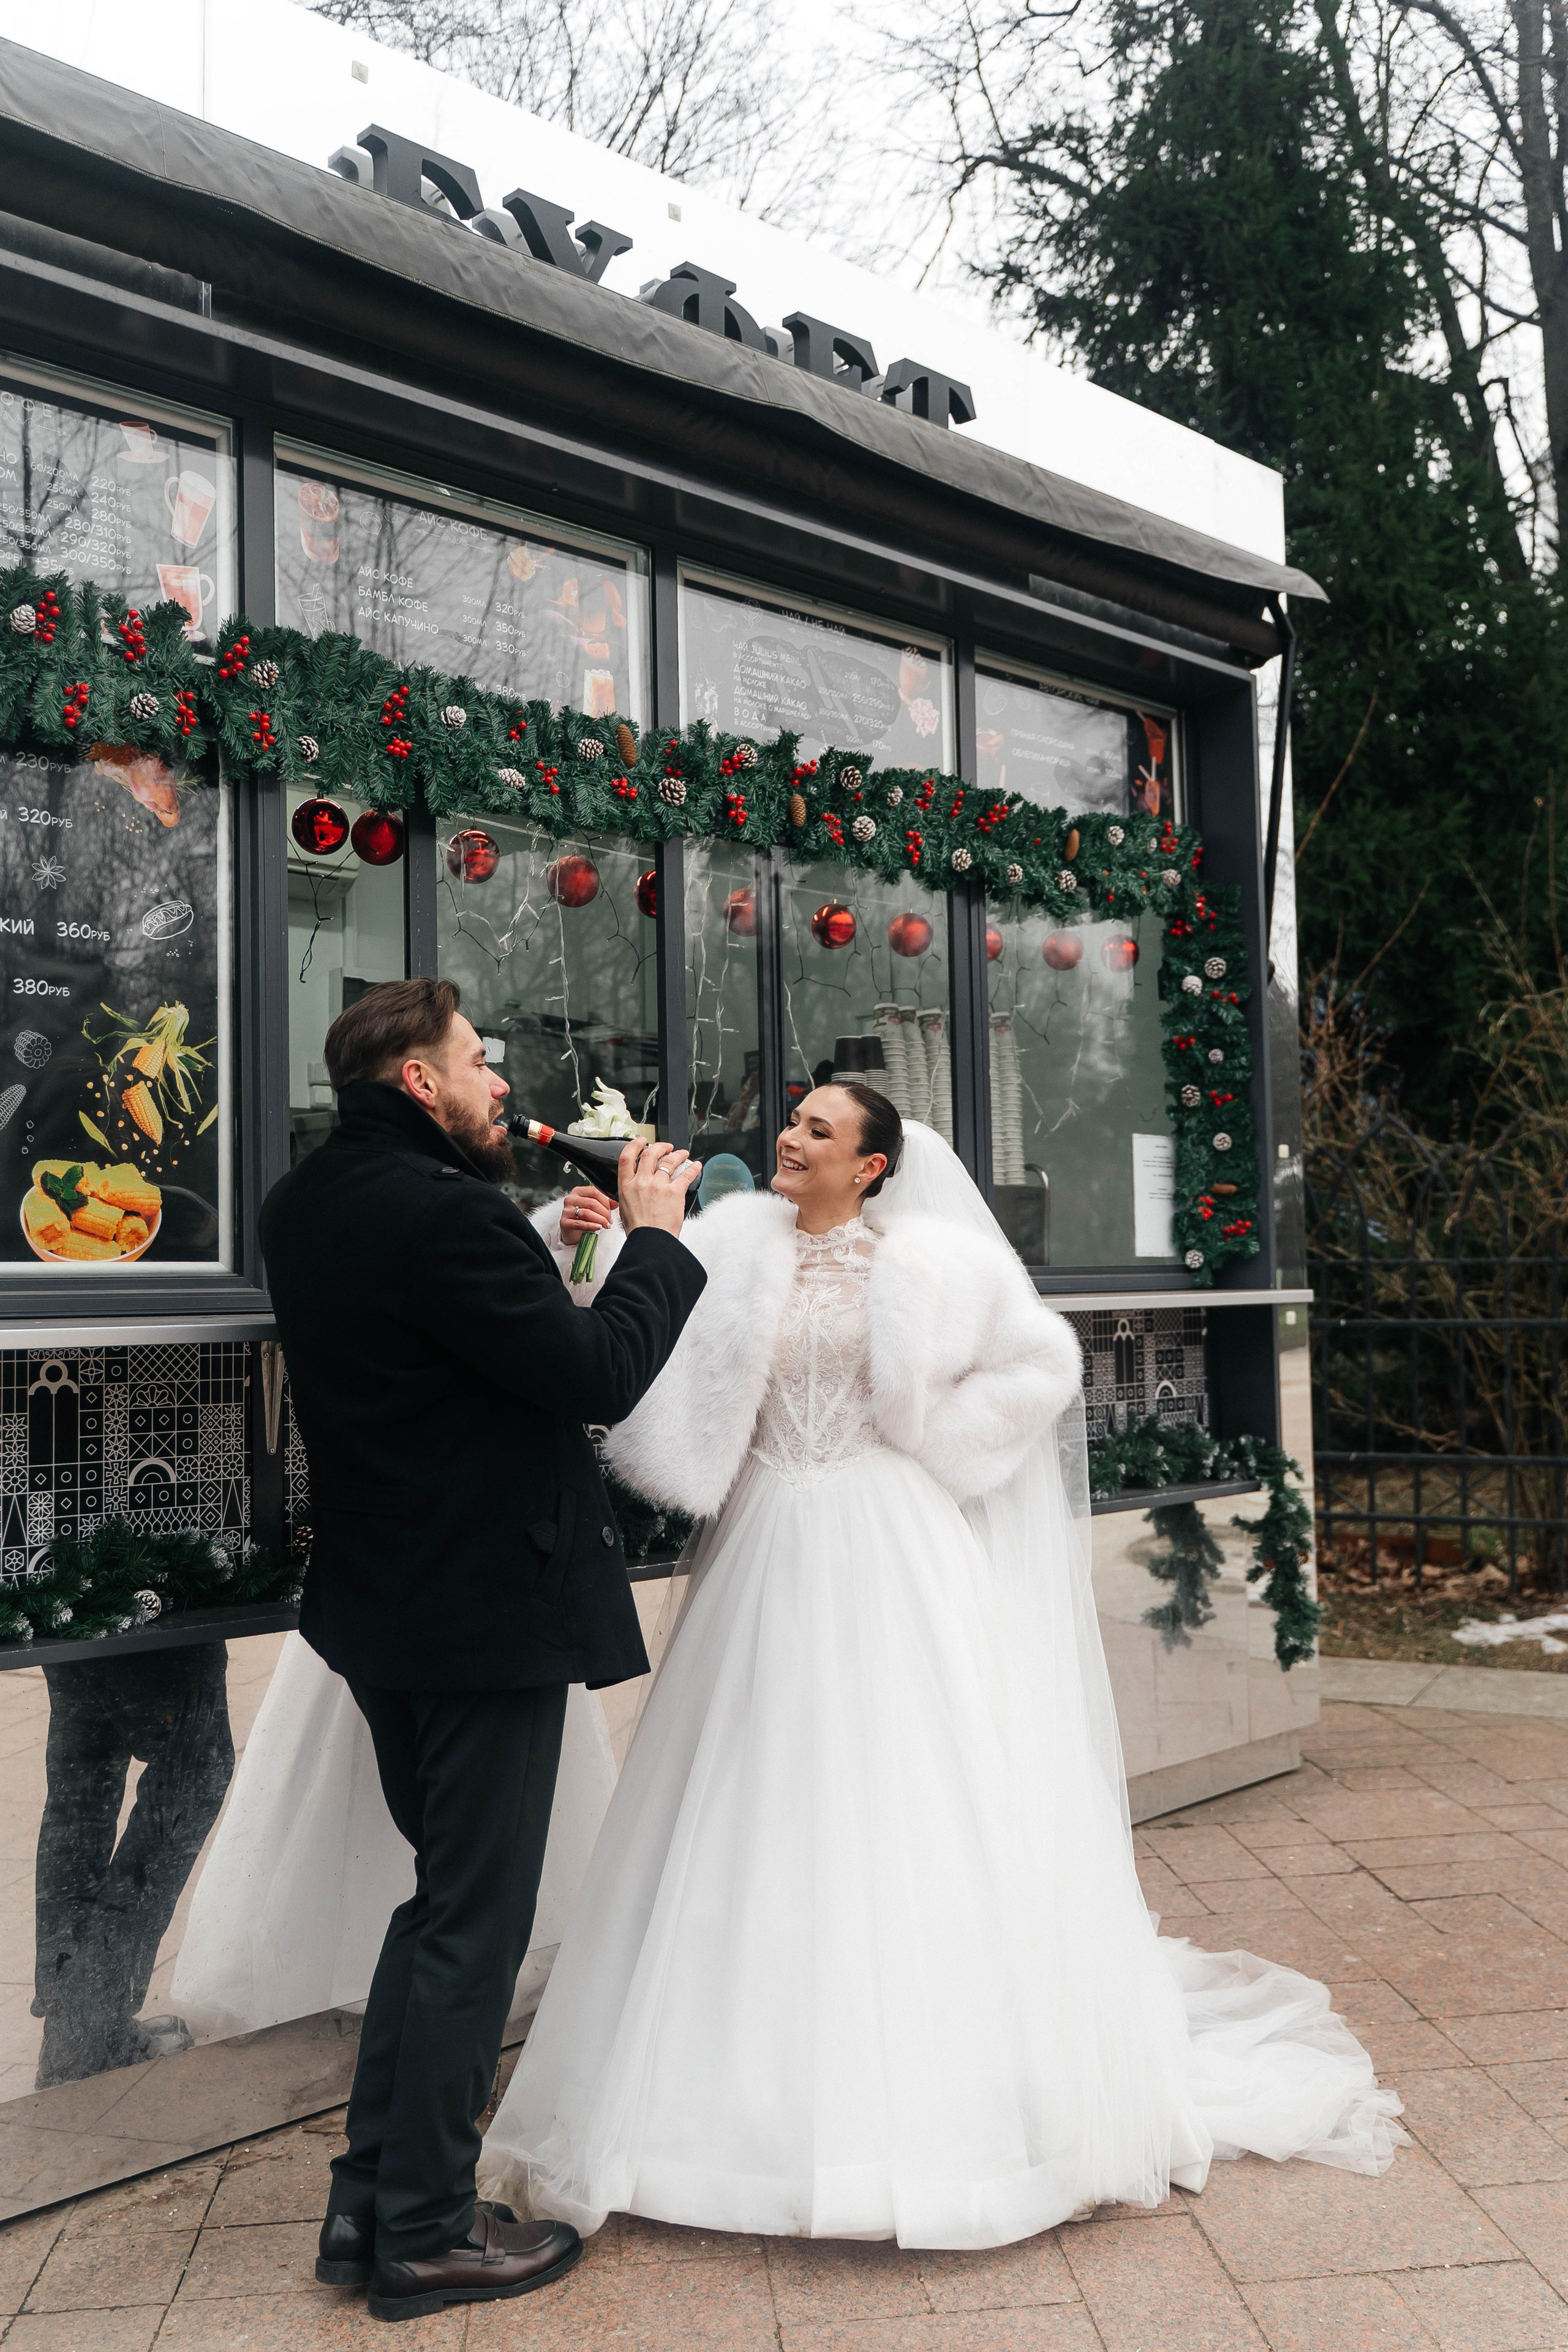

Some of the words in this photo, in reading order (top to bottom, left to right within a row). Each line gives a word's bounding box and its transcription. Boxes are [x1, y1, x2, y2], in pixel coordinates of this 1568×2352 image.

[31, 462, 78, 481] 60/200МЛ
[92, 476, 131, 497] 220РУБ
[47, 483, 79, 498] 250МЛ
[92, 492, 132, 513] 240РУБ
[0, 502, 51, 523] 50/350МЛ
[47, 499, 78, 514] 250МЛ
[92, 508, 131, 528] 280РУБ
[0, 518, 51, 539] 50/350МЛ
[419, 511, 445, 528] АЙС
[450, 519, 488, 541] КОФЕ
[0, 534, 51, 554] 50/350МЛ
[358, 565, 380, 579] АЙС
[383, 571, 413, 589] КОФЕ
[462, 595, 486, 607] 300МЛ
[496, 602, 526, 619] 320РУБ
[358, 586, 395, 603] БАМБЛ
[399, 596, 428, 612] КОФЕ
[462, 615, 487, 627] 300МЛ
[496, 621, 526, 638] 350РУБ
[358, 606, 380, 620] АЙС
[384, 612, 439, 635] КАПУЧИНО
[462, 634, 487, 647] 300МЛ
[496, 641, 526, 657] 330РУБ
[752, 644, 778, 660] JULIUS
[734, 663, 778, 682] ДОМАШНИЙ
[780, 676, 807, 689] КАКАО
[734, 685, 779, 704] ДОМАШНИЙ
[781, 696, 807, 710] КАКАО
[16, 752, 72, 774] 230РУБ
[18, 807, 73, 828] 320РУБ
[57, 922, 111, 941] 360РУБ
[13, 978, 70, 997] 380РУБ
